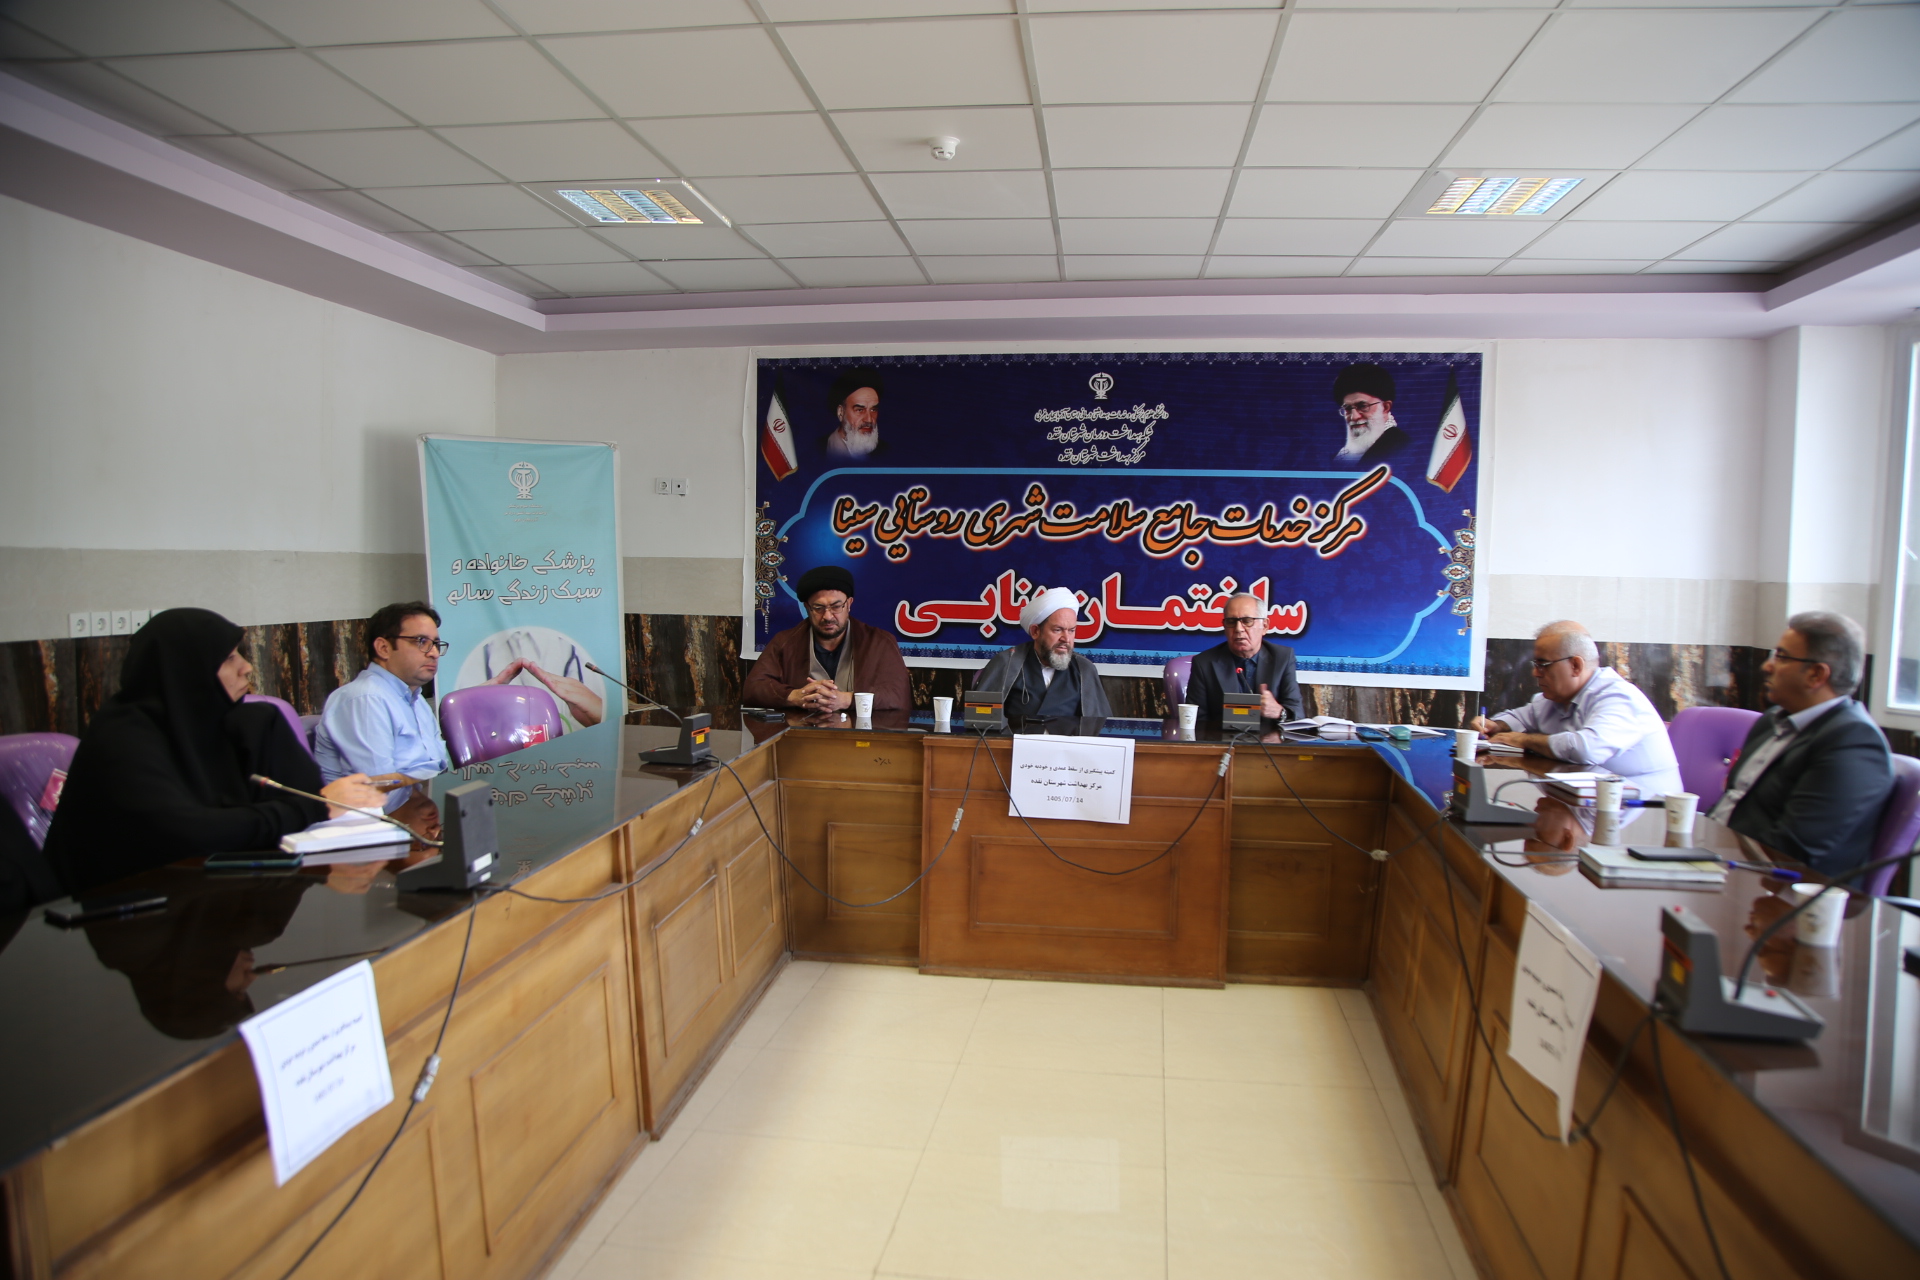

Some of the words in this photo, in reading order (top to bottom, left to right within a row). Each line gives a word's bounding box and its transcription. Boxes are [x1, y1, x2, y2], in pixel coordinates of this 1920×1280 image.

[1047, 426, 1062, 440] نقده
[1060, 423, 1087, 443] شهرستان
[1083, 428, 1105, 443] درمان
[1108, 424, 1143, 443] بهداشت
[1058, 448, 1073, 461] نقده
[1070, 445, 1098, 465] شهرستان
[1096, 445, 1131, 465] بهداشت
[1130, 438, 1147, 463] مرکز
[963, 483, 1044, 547] شهری
[1038, 501, 1148, 538] سلامت
[1208, 496, 1312, 543] خدمات
[1307, 464, 1389, 555] مرکز
[833, 496, 879, 553] سینا
[1143, 502, 1211, 566] جامع
[451, 559, 463, 575] و
[466, 553, 528, 575] خانواده
[531, 550, 595, 576] پزشکی
[447, 583, 494, 605] سالم
[498, 579, 548, 605] زندگی
[551, 580, 602, 603] سبک
[895, 569, 1046, 638] نابی
[1043, 778, 1067, 788] شهرستان
[1089, 783, 1102, 791] مرکز
